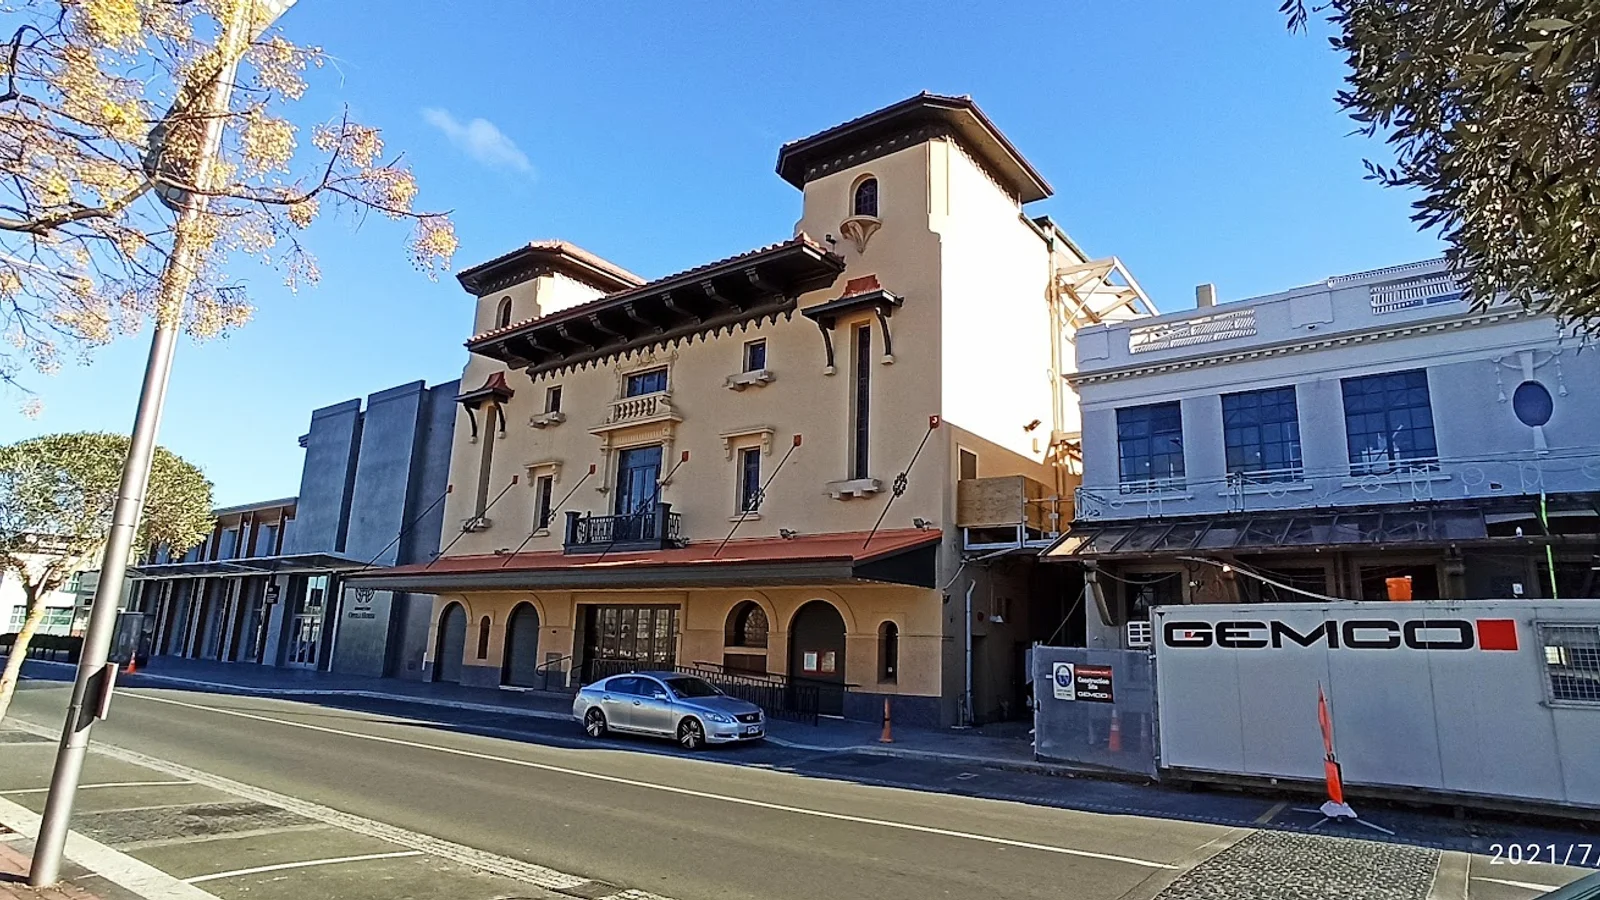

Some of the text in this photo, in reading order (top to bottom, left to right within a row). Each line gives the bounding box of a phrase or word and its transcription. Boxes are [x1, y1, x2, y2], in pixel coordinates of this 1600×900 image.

[1164, 619, 1475, 649] GEMCO
[1077, 676, 1110, 684] Construction
[1077, 691, 1108, 699] GEMCO
